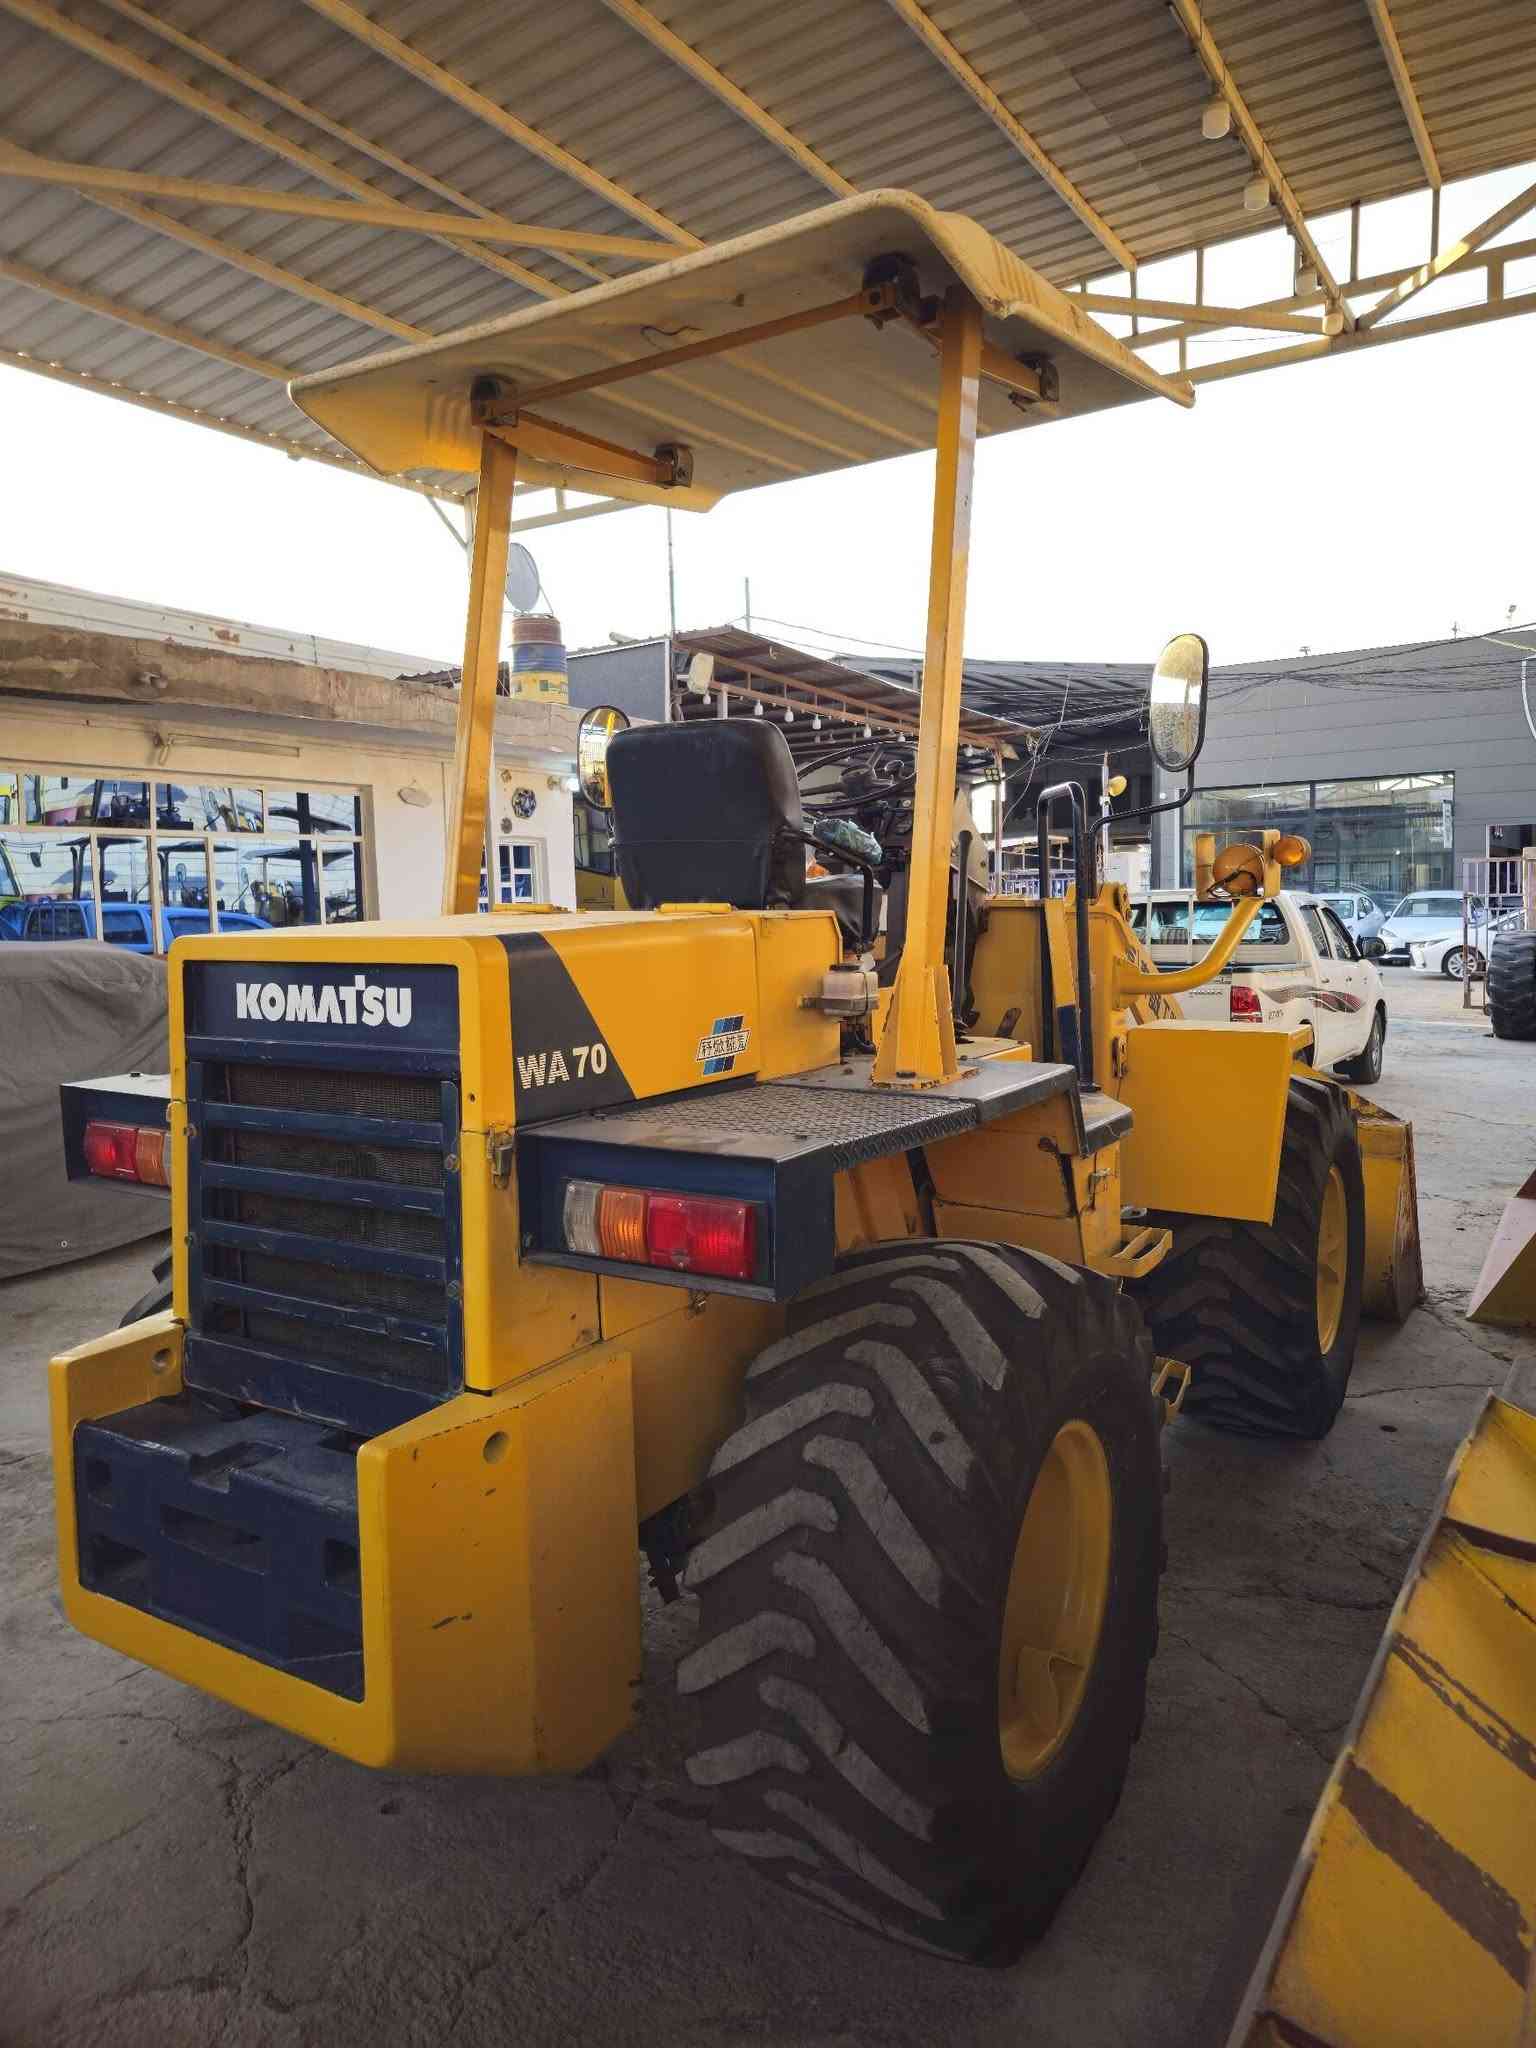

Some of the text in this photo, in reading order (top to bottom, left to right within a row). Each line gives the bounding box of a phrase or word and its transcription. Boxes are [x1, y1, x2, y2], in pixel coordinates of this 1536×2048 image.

[235, 974, 412, 1028] KOMATSU
[517, 1043, 607, 1089] WA 70
